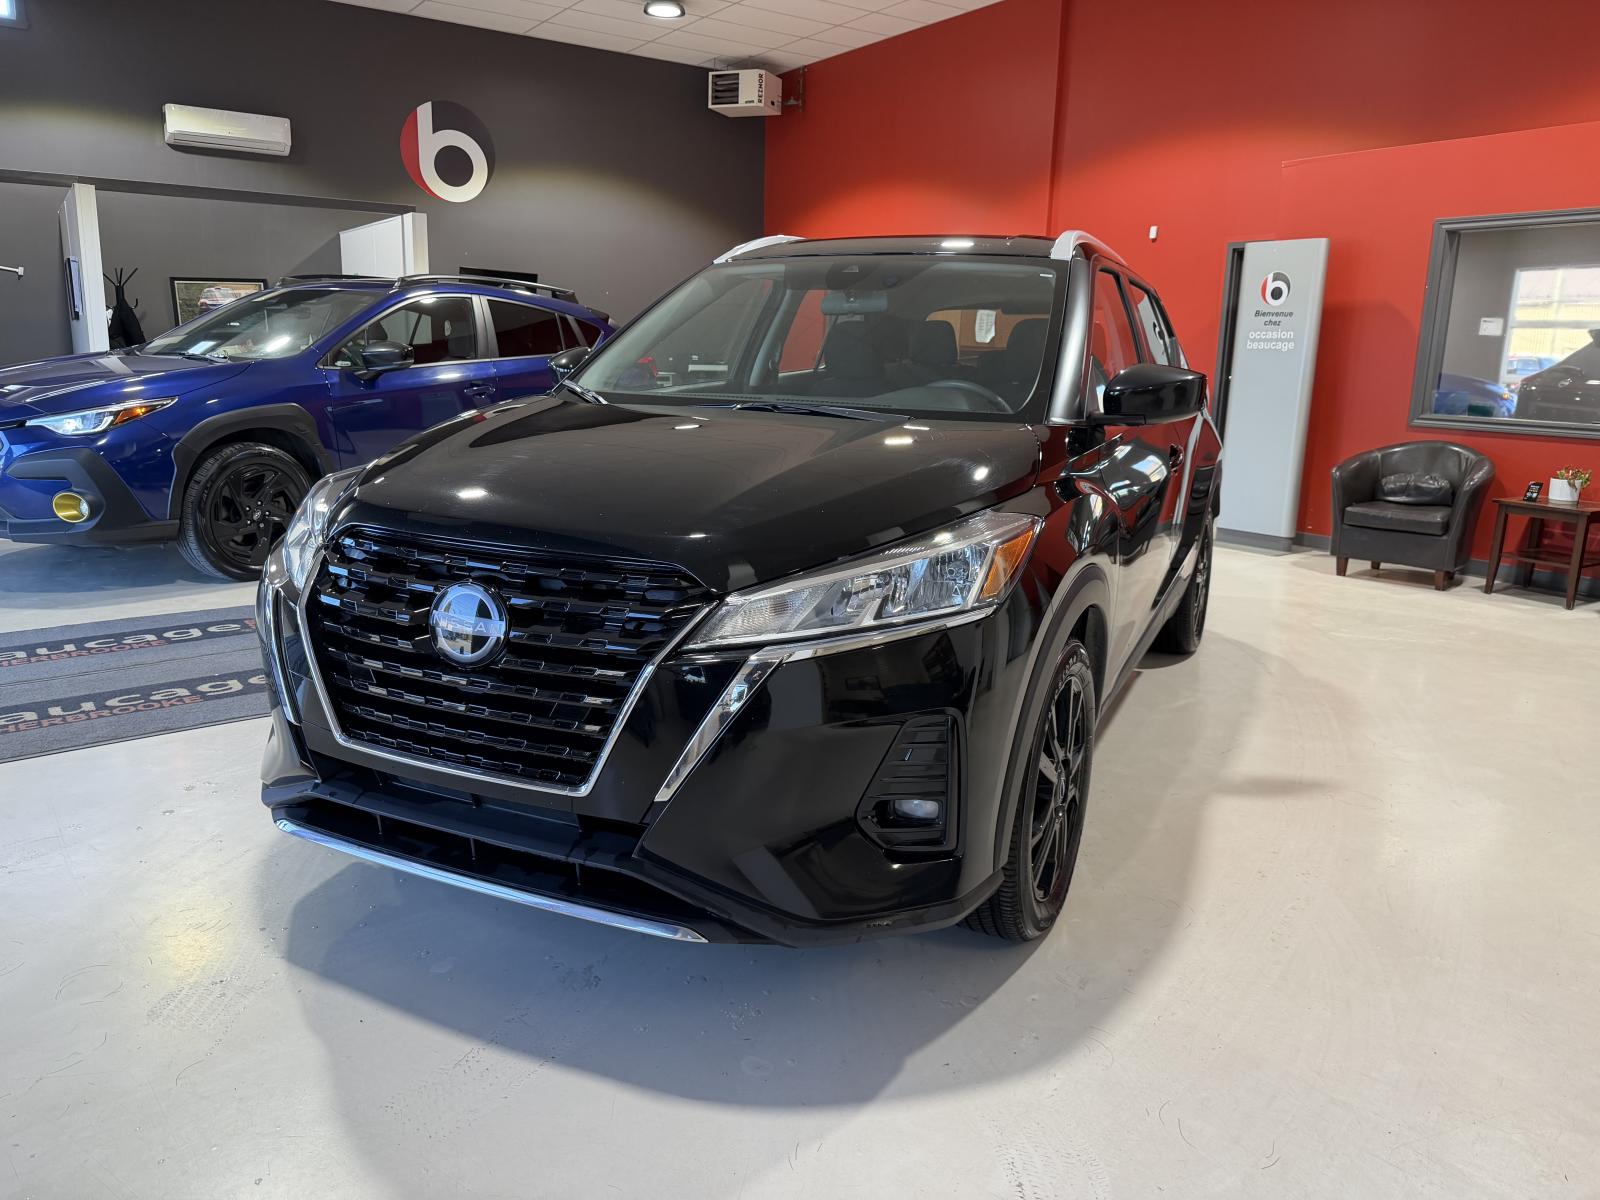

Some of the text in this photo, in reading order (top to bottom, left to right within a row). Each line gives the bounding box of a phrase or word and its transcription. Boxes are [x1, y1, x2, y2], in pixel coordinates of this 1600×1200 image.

[416, 100, 489, 203] b
[1254, 310, 1294, 318] Bienvenue
[1248, 329, 1294, 339] occasion
[1246, 340, 1295, 351] beaucage
[432, 612, 504, 636] NISSAN
